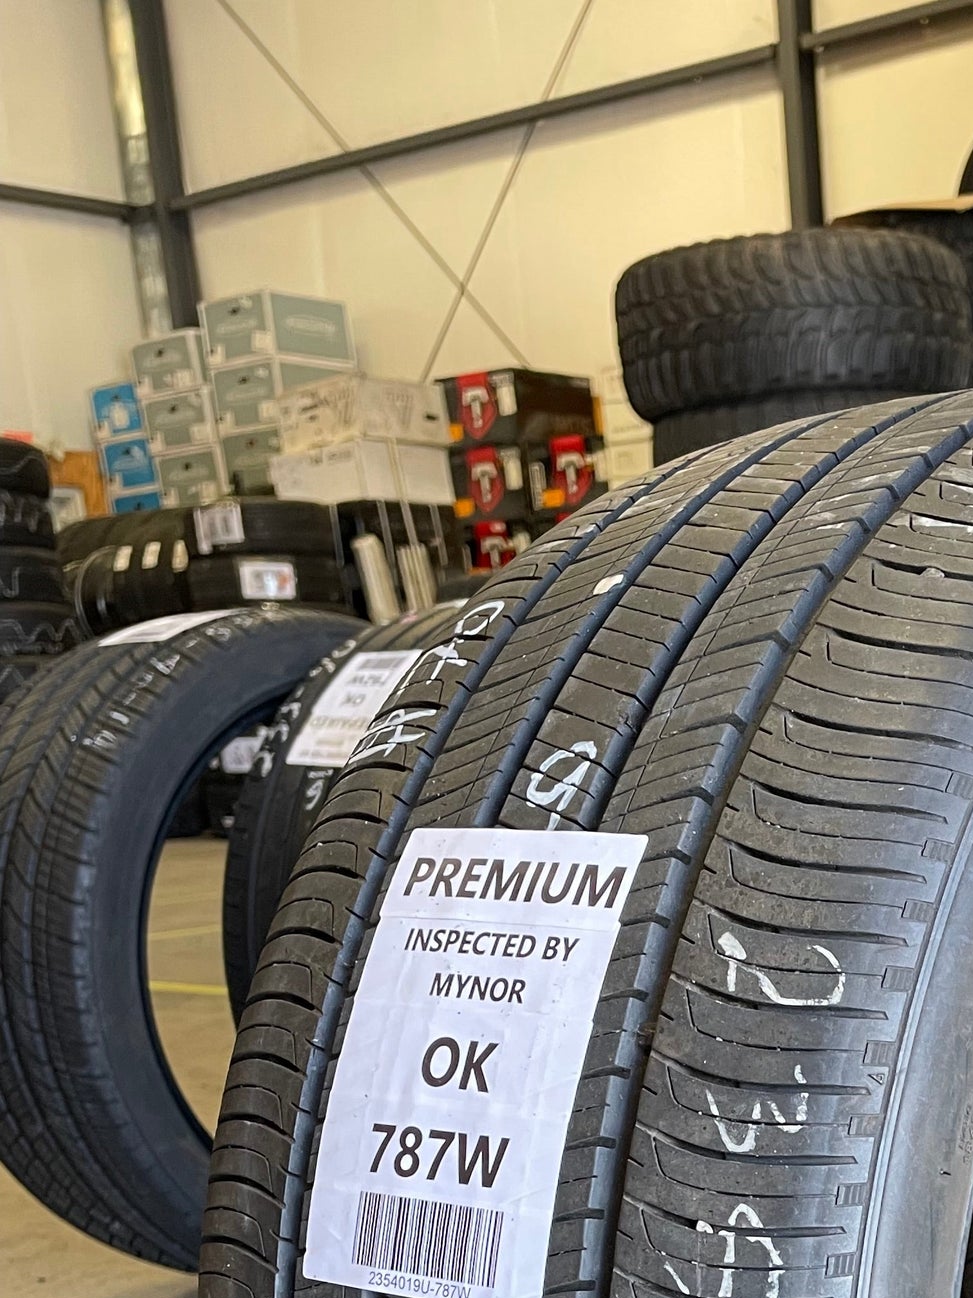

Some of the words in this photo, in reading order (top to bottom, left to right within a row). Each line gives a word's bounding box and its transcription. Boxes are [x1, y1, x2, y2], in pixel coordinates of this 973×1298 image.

[402, 857, 629, 910] PREMIUM
[404, 927, 536, 959] INSPECTED
[541, 935, 580, 962] BY
[429, 972, 527, 1005] MYNOR
[420, 1036, 500, 1094] OK
[368, 1123, 511, 1189] 787W
